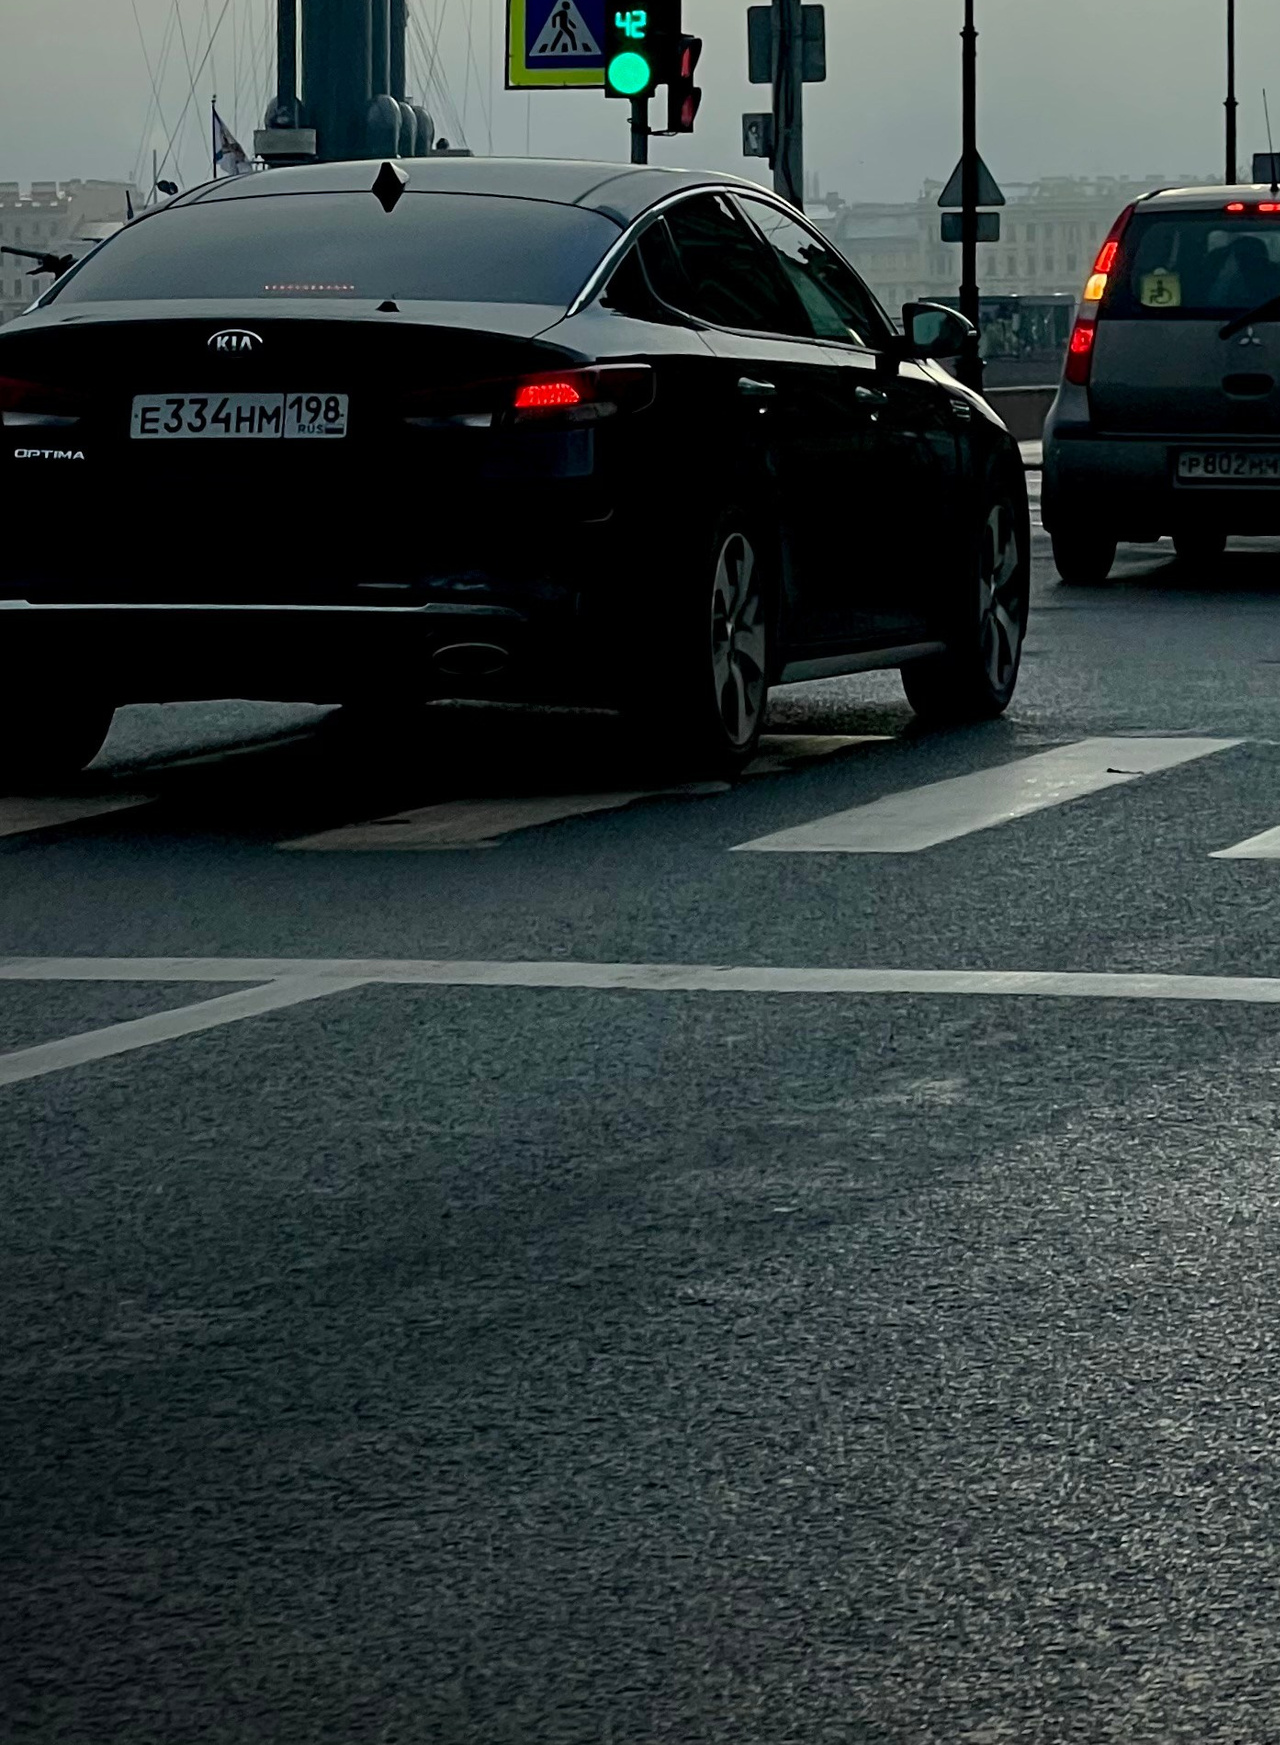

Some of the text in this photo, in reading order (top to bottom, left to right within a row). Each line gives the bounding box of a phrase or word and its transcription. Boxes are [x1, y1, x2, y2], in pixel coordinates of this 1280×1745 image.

[614, 9, 647, 39] 42
[216, 335, 253, 352] KIA
[139, 396, 340, 434] Е334НМ 198
[297, 424, 324, 434] RUS
[14, 448, 86, 460] OPTIMA
